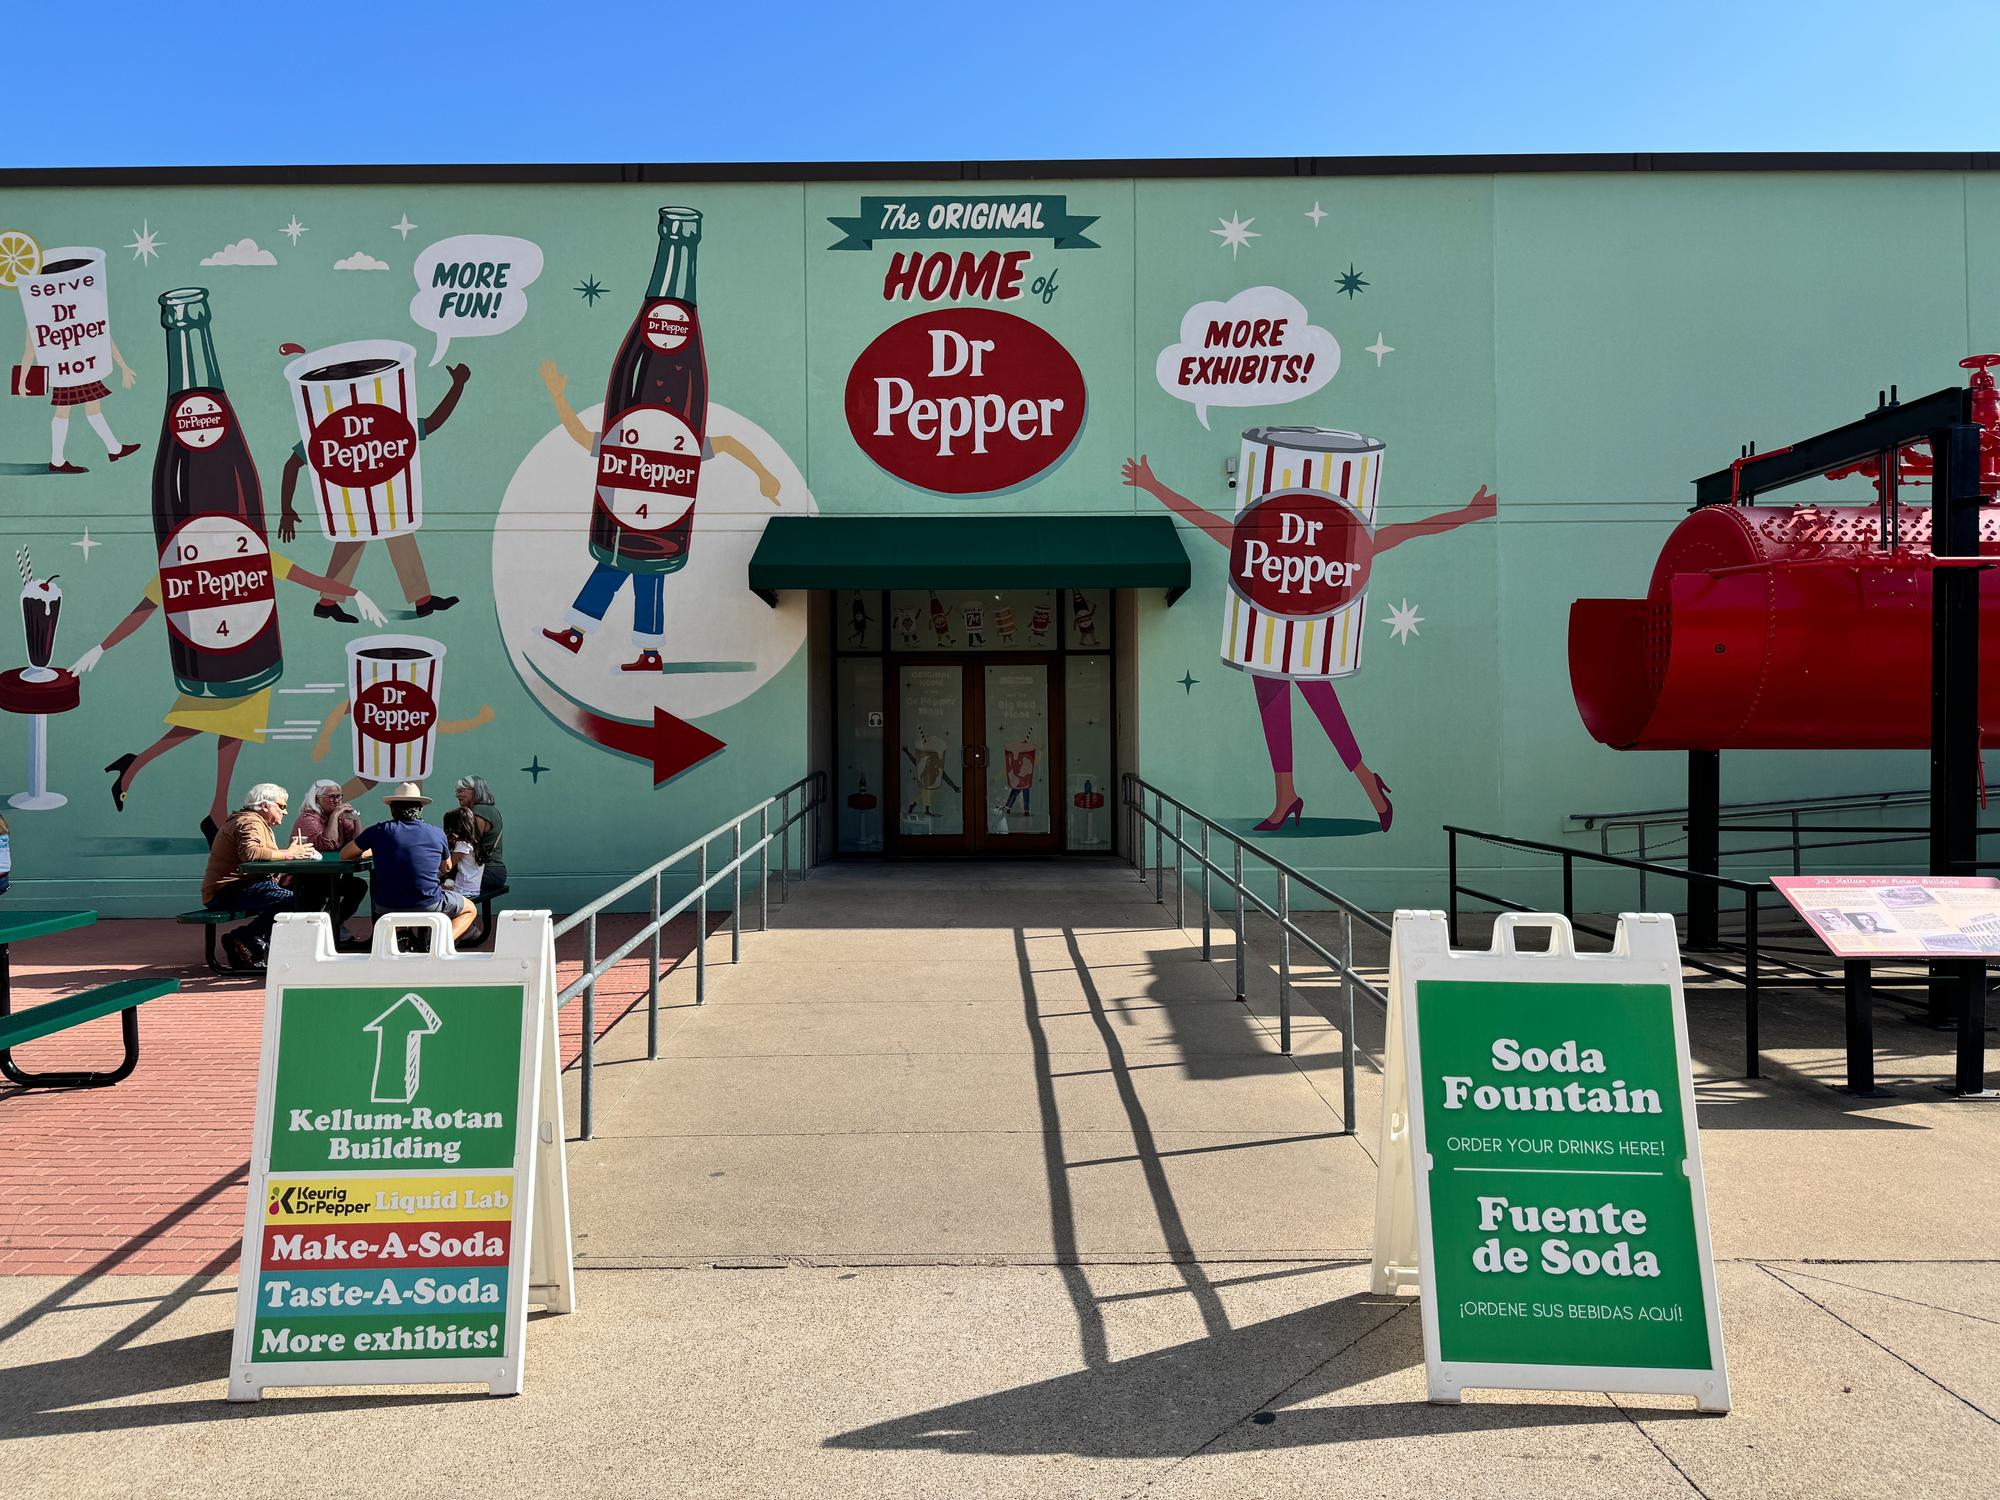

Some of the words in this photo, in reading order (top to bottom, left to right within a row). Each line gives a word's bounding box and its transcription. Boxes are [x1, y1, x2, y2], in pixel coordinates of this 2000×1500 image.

[880, 204, 921, 230] The
[927, 202, 1045, 230] ORIGINAL
[30, 275, 95, 297] serve
[432, 262, 511, 289] MORE
[883, 250, 1032, 302] HOME
[1030, 267, 1059, 304] of
[52, 304, 77, 322] Dr
[438, 292, 503, 319] FUN!
[36, 320, 106, 350] Pepper
[648, 321, 660, 330] Dr
[661, 320, 689, 335] Pepper
[1204, 318, 1288, 349] MORE
[58, 356, 96, 375] HOT
[927, 329, 996, 378] Dr
[1177, 353, 1316, 386] EXHIBITS!
[181, 407, 193, 415] 10
[207, 403, 215, 411] 2
[872, 377, 1065, 456] Pepper
[198, 434, 206, 443] 4
[342, 415, 374, 438] Dr
[619, 428, 639, 445] 10
[673, 435, 684, 451] 2
[320, 437, 409, 474] Pepper
[602, 453, 627, 474] Dr
[629, 452, 696, 488] Pepper
[635, 503, 648, 520] 4
[1276, 512, 1324, 546] Dr
[176, 544, 199, 562] 10
[236, 536, 249, 553] 2
[1240, 539, 1361, 594] Pepper
[166, 577, 193, 599] Dr
[196, 568, 268, 600] Pepper
[216, 620, 230, 637] 4
[382, 687, 406, 705] Dr
[363, 702, 430, 731] Pepper
[1491, 1038, 1606, 1073] Soda
[1442, 1076, 1662, 1113] Fountain
[288, 1107, 503, 1131] Kellum-Rotan
[327, 1136, 461, 1164] Building
[1447, 1137, 1502, 1152] ORDER
[1507, 1138, 1553, 1153] YOUR
[1558, 1139, 1614, 1155] DRINKS
[1619, 1141, 1665, 1156] HERE!
[297, 1186, 347, 1202] Keurig
[374, 1190, 457, 1215] Liquid
[463, 1189, 510, 1209] Lab
[1477, 1196, 1647, 1234] Fuente
[270, 1230, 504, 1261] Make-A-Soda
[1472, 1237, 1528, 1273] de
[1540, 1238, 1661, 1277] Soda
[264, 1277, 499, 1308] Taste-A-Soda
[1460, 1301, 1528, 1319] ¡ORDENE
[1532, 1303, 1564, 1318] SUS
[1568, 1304, 1634, 1320] BEBIDAS
[1638, 1303, 1683, 1322] AQUÍ!
[259, 1327, 346, 1354] More
[354, 1324, 499, 1351] exhibits!
